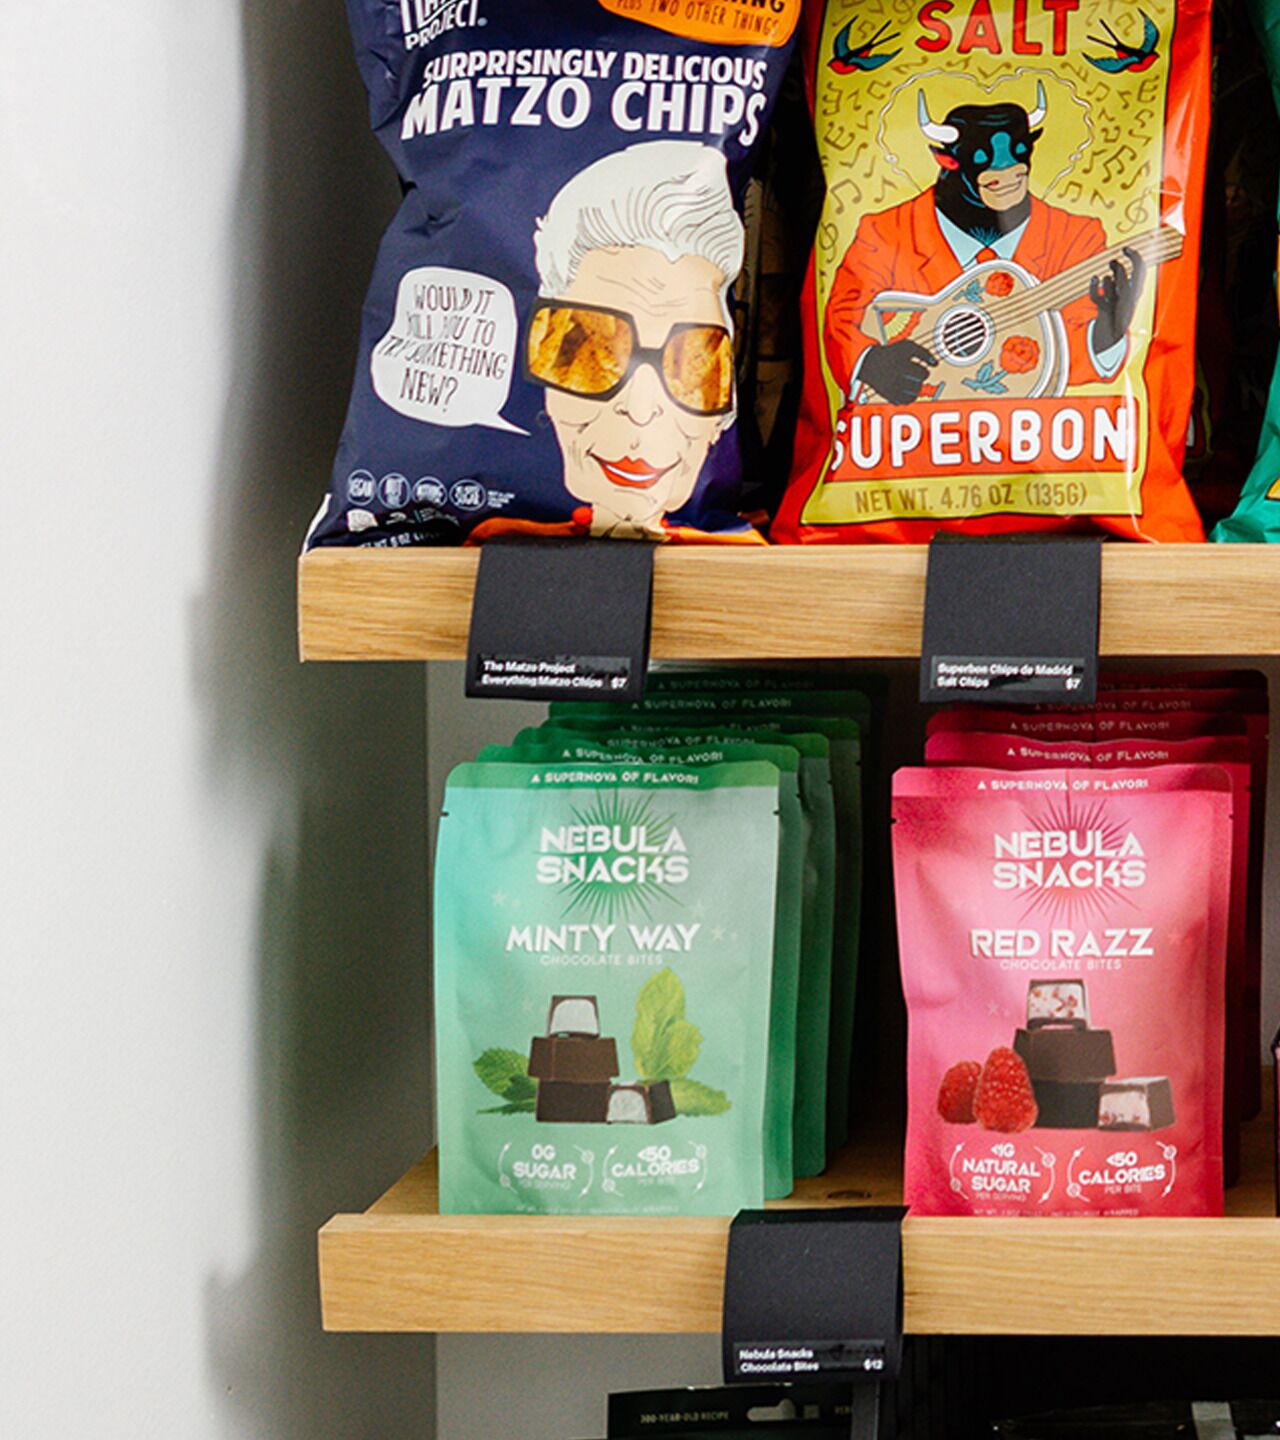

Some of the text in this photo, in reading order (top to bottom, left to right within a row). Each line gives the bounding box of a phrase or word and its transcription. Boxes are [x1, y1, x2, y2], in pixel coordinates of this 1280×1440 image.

[424, 50, 767, 88] SURPRISINGLY DELICIOUS
[402, 77, 766, 146] MATZO CHIPS
[831, 407, 1128, 470] SUPERBON
[484, 660, 576, 674] The Matzo Project
[541, 826, 687, 853] NEBULA
[535, 857, 689, 884] SNACKS
[505, 924, 700, 952] MINTY WAY
[971, 928, 1155, 957] RED RAZZ
[740, 1348, 776, 1360] Nebula
[740, 1362, 792, 1372] Chocolate
[794, 1362, 820, 1371] Bites
